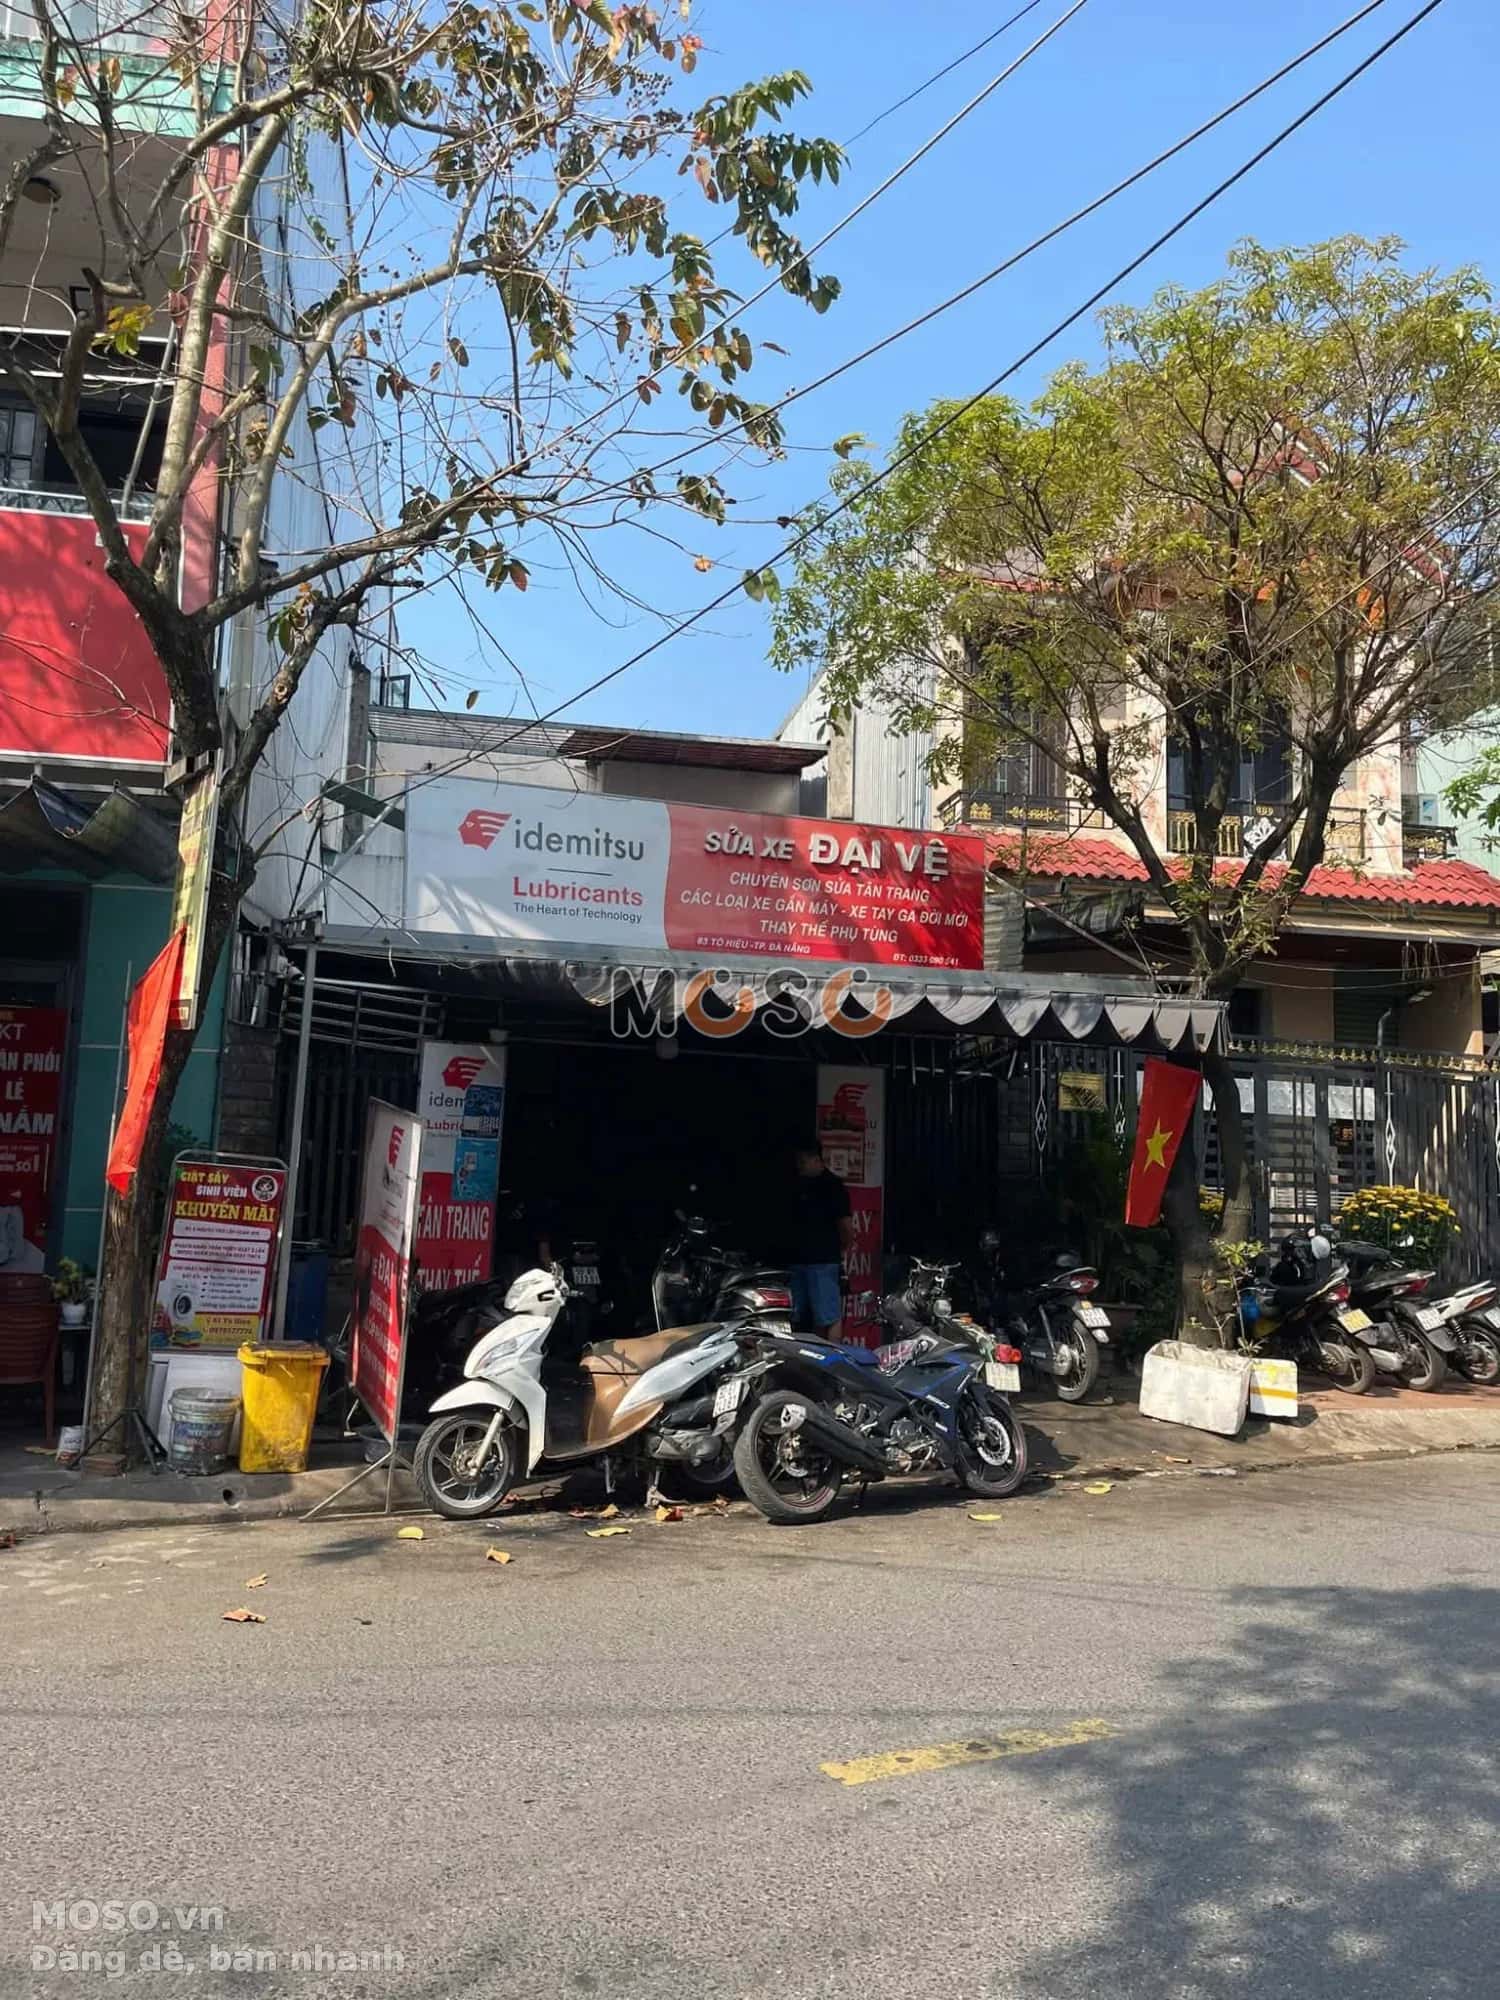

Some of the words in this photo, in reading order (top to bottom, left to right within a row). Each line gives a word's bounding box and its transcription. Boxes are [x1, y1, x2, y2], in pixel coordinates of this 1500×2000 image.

[515, 819, 644, 860] idemitsu
[704, 824, 754, 856] SỬA
[760, 837, 795, 860] XE
[808, 832, 881, 873] ĐẠI
[894, 838, 949, 881] VỆ
[513, 876, 643, 907] Lubricants
[729, 870, 788, 890] CHUYÊN
[792, 877, 821, 893] SƠN
[825, 878, 852, 895] SỬA
[887, 886, 930, 902] TRANG
[513, 902, 534, 913] The
[536, 903, 567, 916] Heart
[569, 906, 580, 917] of
[582, 907, 643, 924] Technology
[680, 887, 711, 906] CÁC
[715, 894, 748, 911] LOẠI
[751, 897, 772, 911] XE
[808, 900, 838, 916] MÁY
[849, 905, 868, 919] XE
[871, 907, 895, 921] TAY
[897, 909, 916, 923] GA
[919, 909, 941, 926] ĐỜI
[944, 911, 968, 928] MỚI
[710, 937, 725, 947] TÔ
[760, 919, 797, 936] THAY
[800, 919, 828, 937] THẾ
[830, 925, 858, 942] PHỤ
[862, 926, 899, 943] TÙNG
[23, 1046, 61, 1073] PHỐI
[196, 1184, 221, 1196] SINH
[175, 1198, 241, 1220] KHUYẾN
[445, 1205, 489, 1241] TRANG
